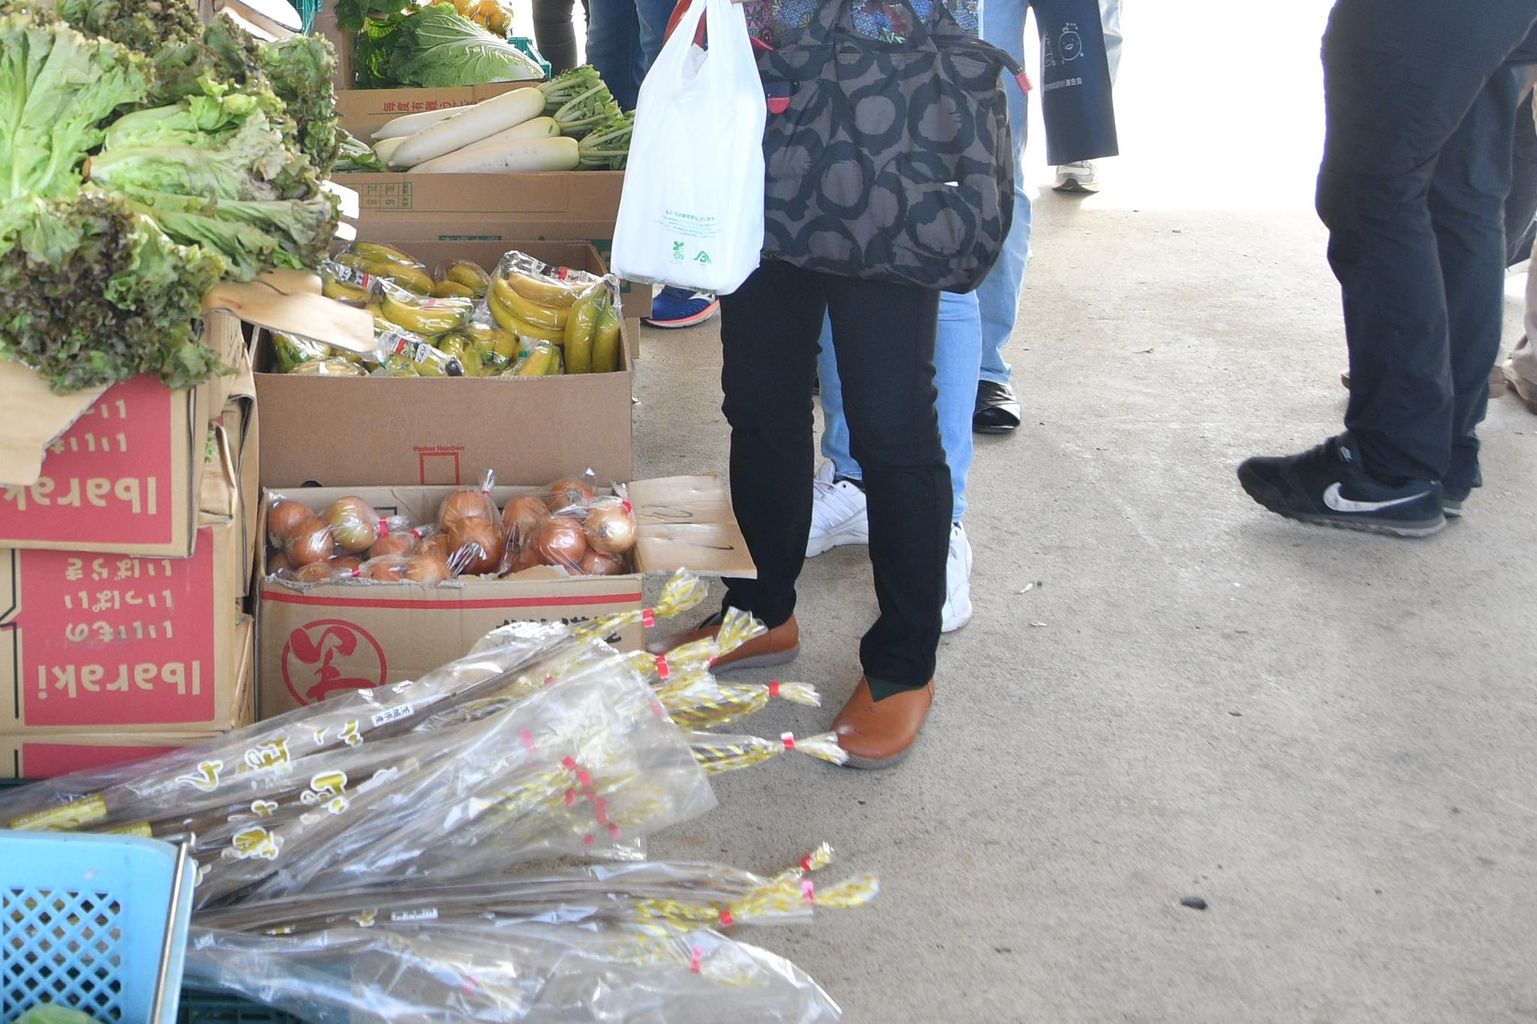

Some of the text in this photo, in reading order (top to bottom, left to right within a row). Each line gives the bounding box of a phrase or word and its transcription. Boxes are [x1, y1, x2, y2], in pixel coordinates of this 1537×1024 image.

[50, 433, 128, 454] いい
[65, 558, 173, 582] いばらき
[65, 589, 173, 612] いっぱい
[65, 620, 174, 643] いいもの
[37, 660, 202, 700] Ibaraki
